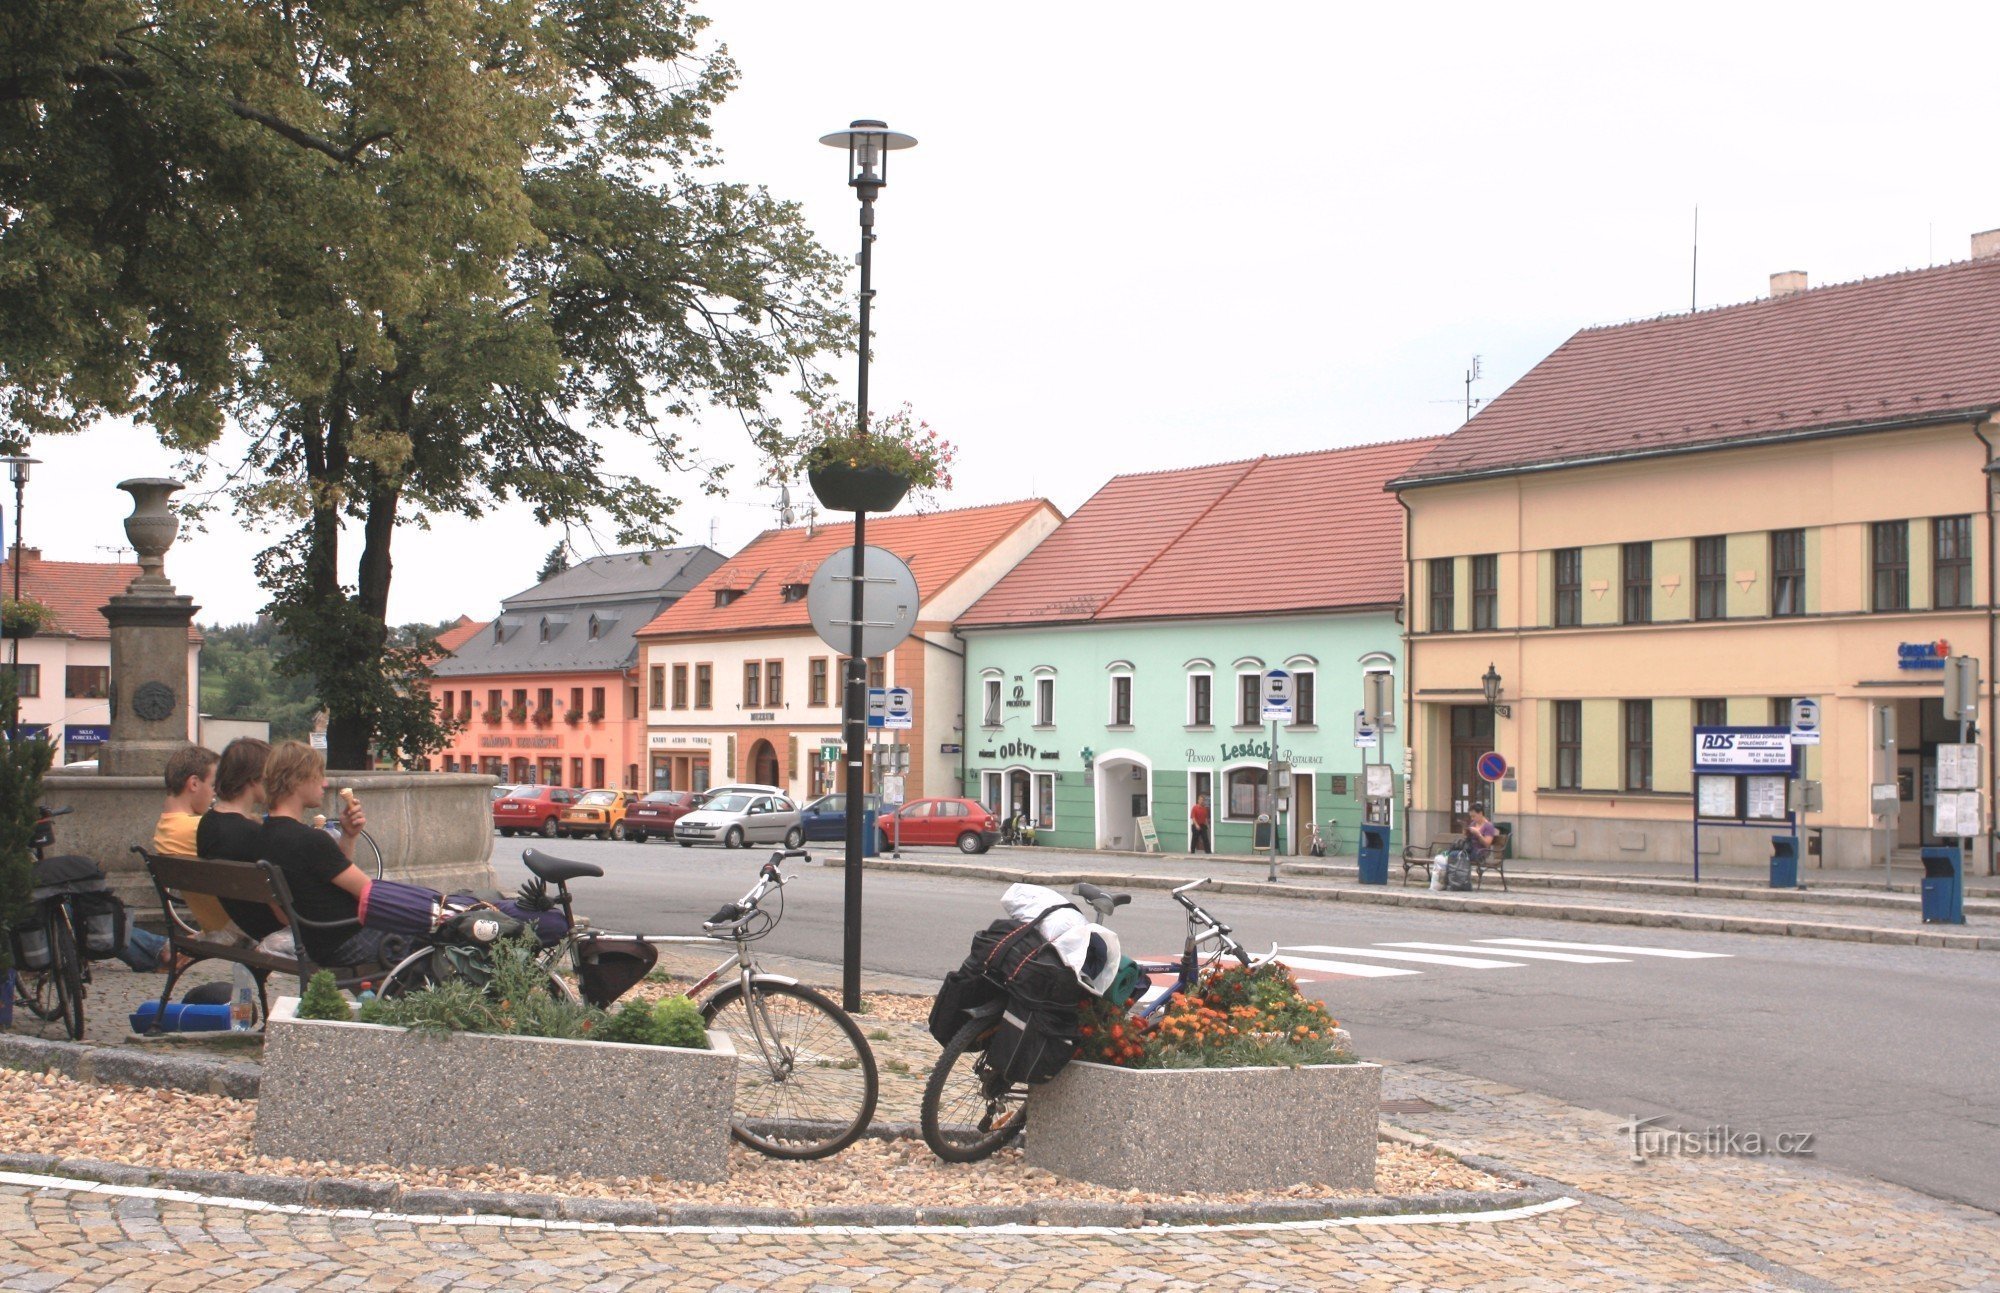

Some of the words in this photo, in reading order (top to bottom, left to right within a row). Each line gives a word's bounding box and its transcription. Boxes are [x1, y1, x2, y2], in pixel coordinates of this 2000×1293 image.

[750, 712, 775, 721] MUZEUM
[1000, 737, 1036, 759] ODĚVY
[1702, 734, 1735, 750] BDS
